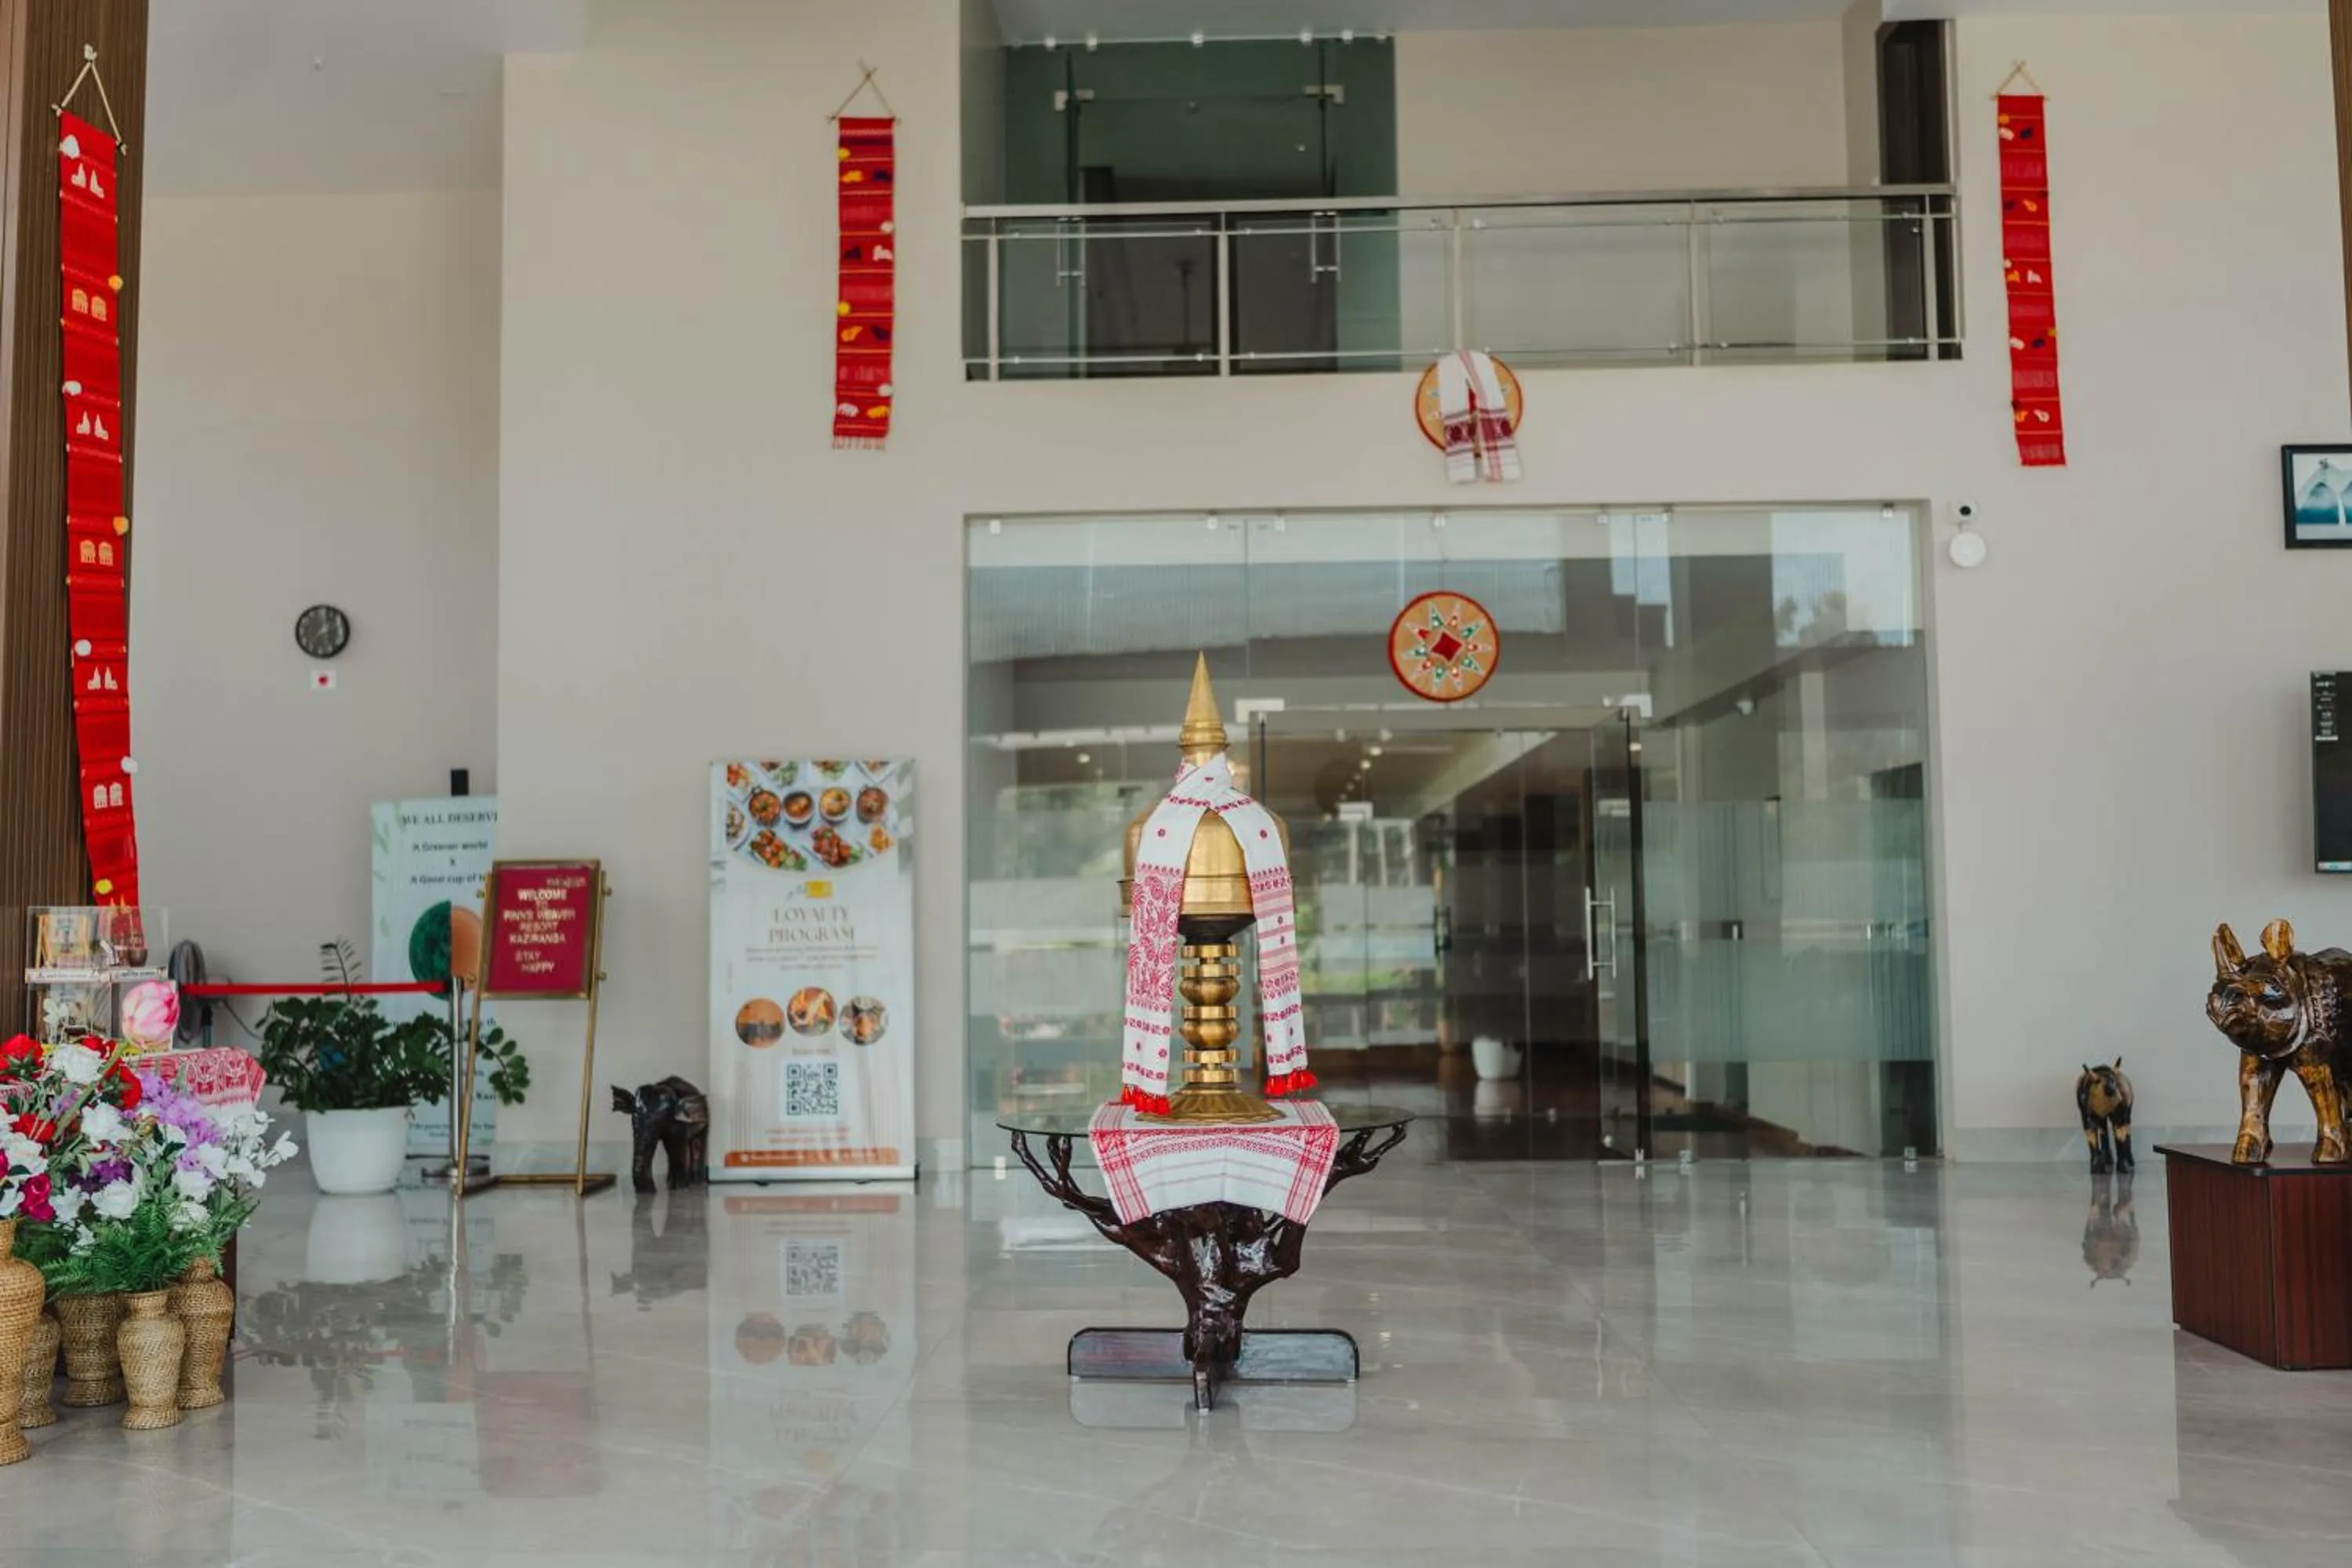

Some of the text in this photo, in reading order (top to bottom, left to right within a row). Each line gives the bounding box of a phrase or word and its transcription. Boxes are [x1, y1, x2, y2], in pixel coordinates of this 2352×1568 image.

[425, 814, 445, 824] ALL
[462, 840, 488, 850] world
[517, 887, 568, 902] WELCOME
[774, 905, 849, 923] LOYALTY
[768, 926, 855, 943] PROGRAM
